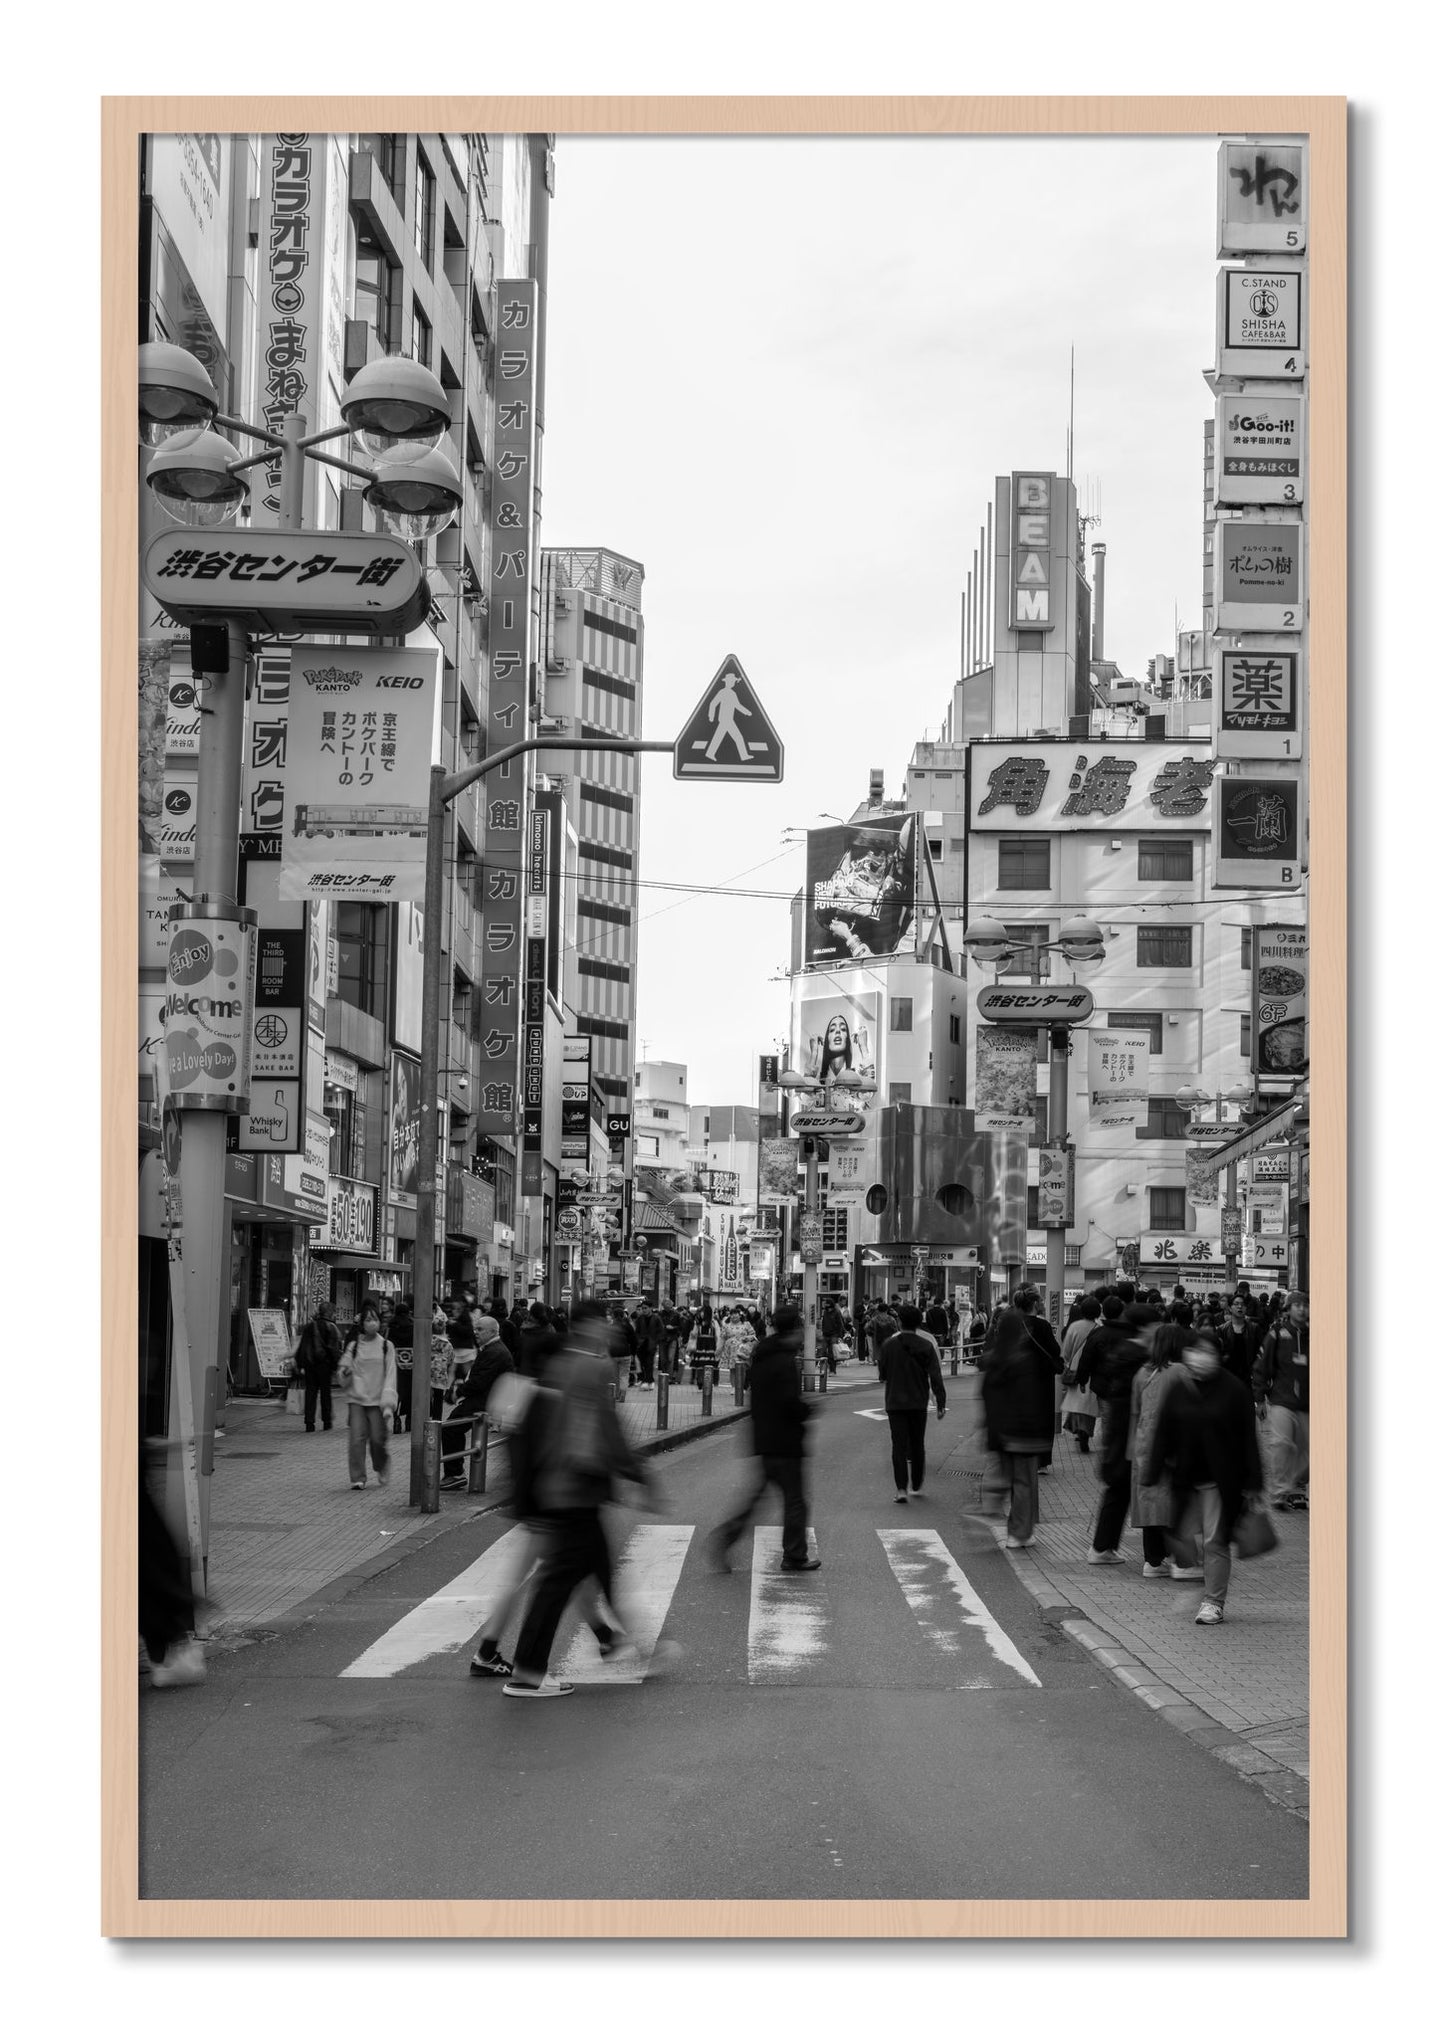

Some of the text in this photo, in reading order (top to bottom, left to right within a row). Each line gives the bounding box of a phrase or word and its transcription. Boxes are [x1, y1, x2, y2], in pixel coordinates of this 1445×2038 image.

[270, 147, 312, 285] カラオケ
[1286, 231, 1299, 246] 5
[1241, 278, 1287, 288] C.STAND
[1241, 319, 1286, 329] SHISHA
[1241, 330, 1286, 338] CAFE&BAR
[1284, 357, 1297, 373] 4
[1228, 461, 1296, 473] 全身もみほぐし
[1283, 483, 1296, 500] 3
[1016, 476, 1050, 622] BEAM
[157, 549, 406, 587] 渋谷センター街
[1283, 610, 1295, 627] 2
[315, 684, 351, 692] KANTO
[375, 675, 425, 690] KEIO
[1232, 659, 1283, 710] 薬
[1226, 713, 1288, 728] マツモトキヨシ
[320, 711, 337, 755] 冒険へ
[339, 711, 356, 786] カントーの
[380, 712, 398, 772] 京王線で
[1283, 738, 1291, 754] 1
[978, 756, 1217, 816] 角海老
[534, 815, 543, 851] kimono
[307, 873, 396, 887] 渋谷センター街
[1281, 867, 1293, 883] B
[262, 949, 284, 957] THIRD
[266, 941, 281, 949] THE
[170, 943, 210, 977] Enjoy
[262, 977, 283, 985] ROOM
[167, 992, 243, 1019] Welcome
[984, 994, 1087, 1008] 渋谷センター街
[1260, 1003, 1288, 1024] 6F
[182, 1051, 213, 1071] Lovely
[215, 1051, 235, 1066] Day!
[250, 1116, 284, 1127] Whisky
[609, 1120, 629, 1131] GU
[249, 1126, 270, 1134] Bank
[1154, 1239, 1213, 1261] 兆楽
[727, 1237, 736, 1280] BEER
